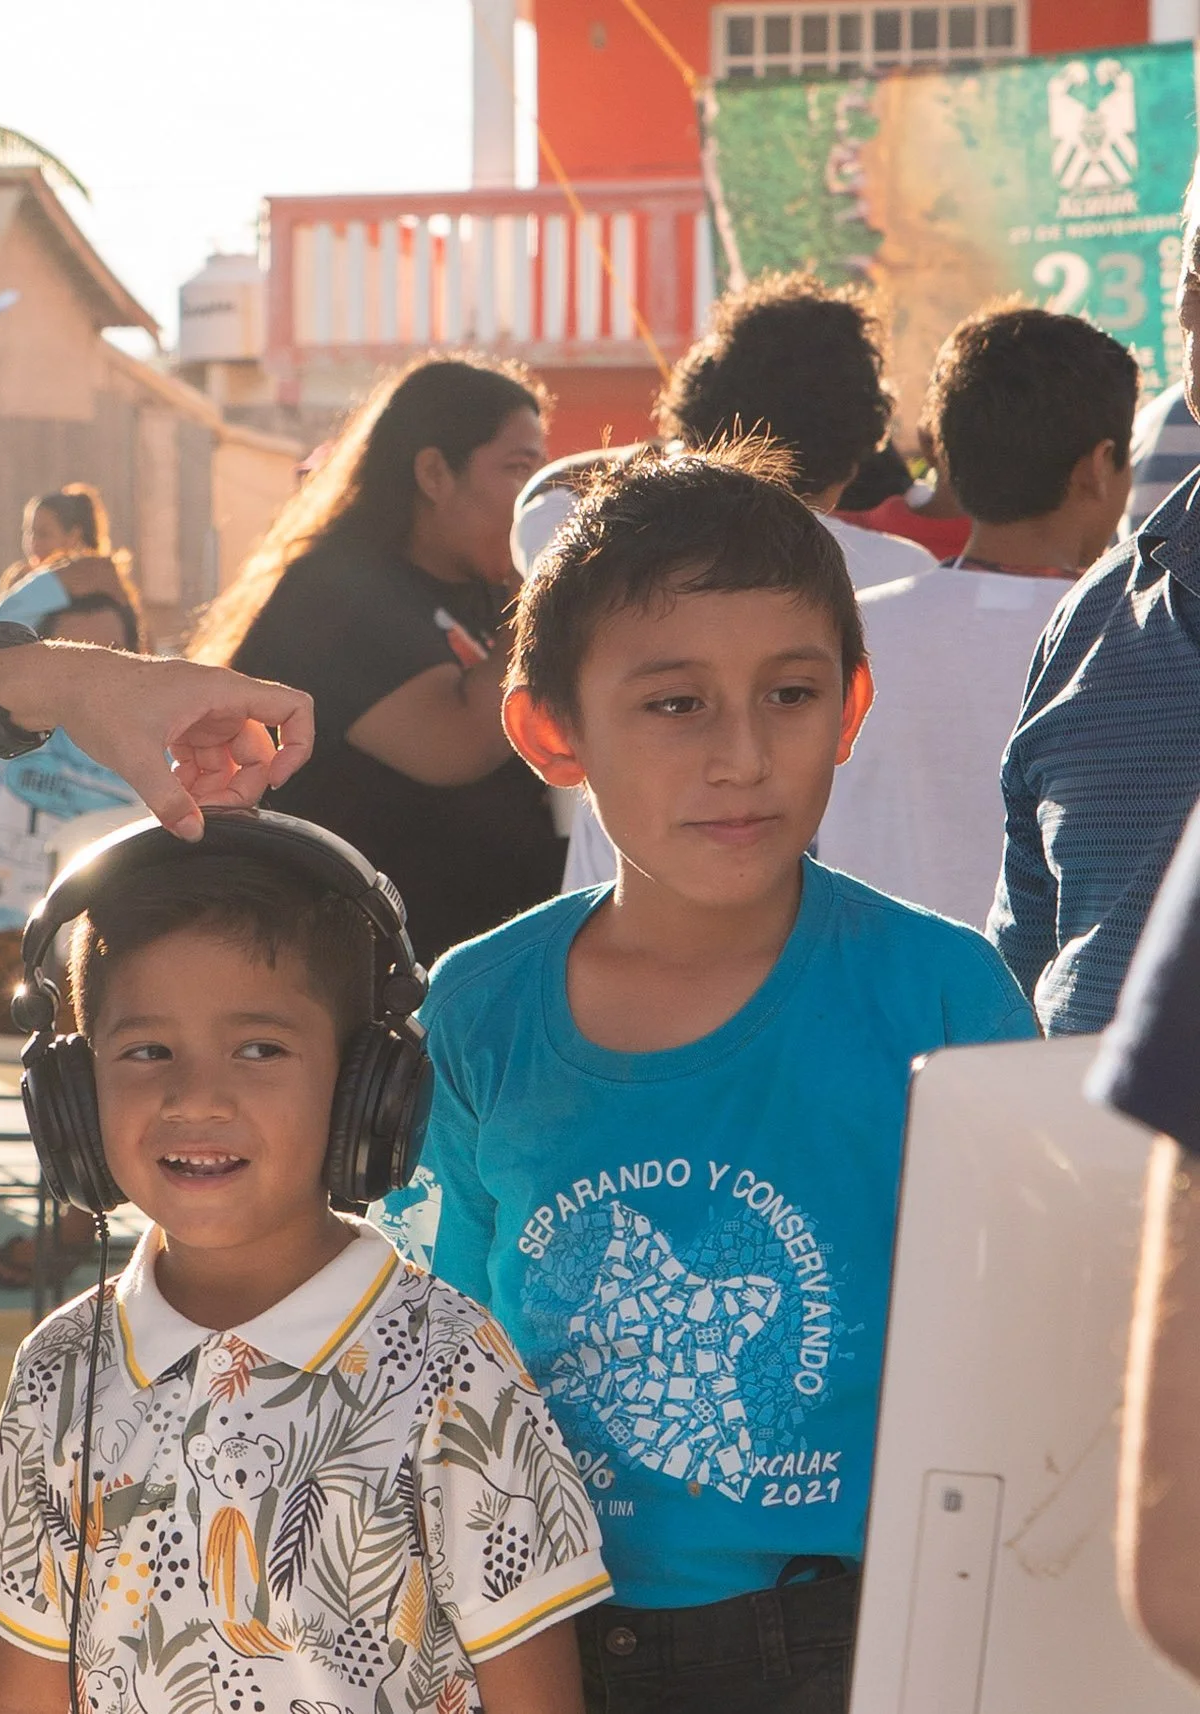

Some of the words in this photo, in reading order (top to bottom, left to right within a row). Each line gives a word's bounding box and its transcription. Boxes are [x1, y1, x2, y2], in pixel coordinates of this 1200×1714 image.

[518, 1158, 691, 1259] SEPARANDO
[708, 1160, 731, 1191] Y
[732, 1169, 831, 1396] CONSERVANDO
[751, 1451, 842, 1478] XCALAK
[761, 1478, 841, 1507] 2021
[609, 1500, 634, 1516] UNA
